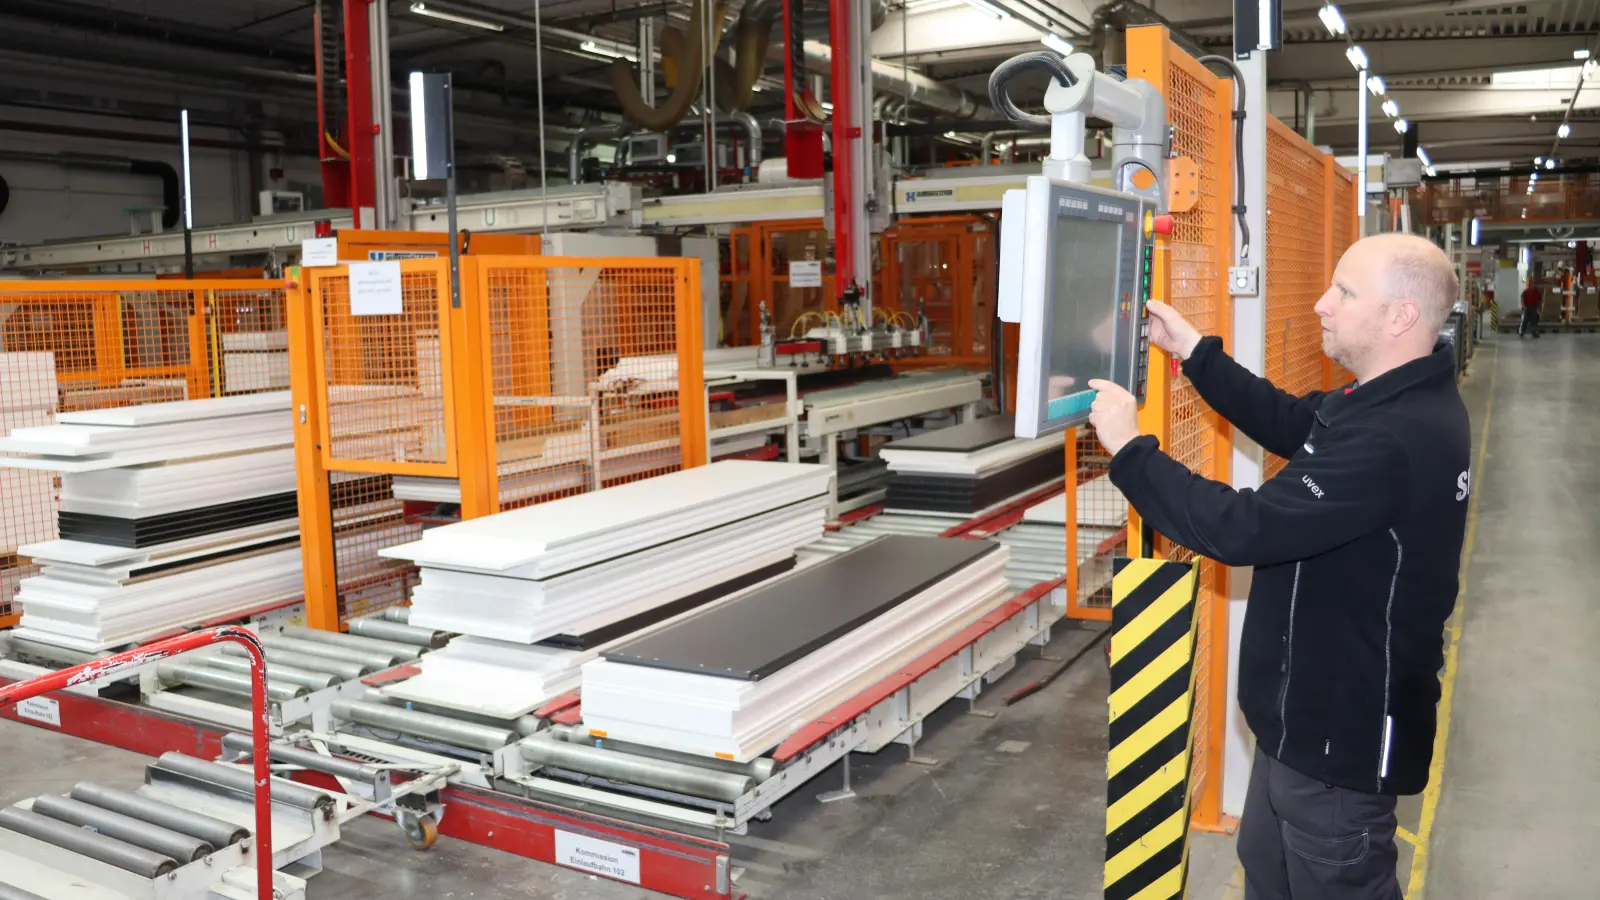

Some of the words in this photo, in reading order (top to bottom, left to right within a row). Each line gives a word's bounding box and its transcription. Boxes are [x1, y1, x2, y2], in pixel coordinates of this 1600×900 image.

[208, 233, 217, 248] H
[1302, 474, 1325, 499] uvex
[575, 847, 619, 864] Kommission
[569, 855, 611, 873] Einlaufbahn
[613, 867, 625, 877] 102
